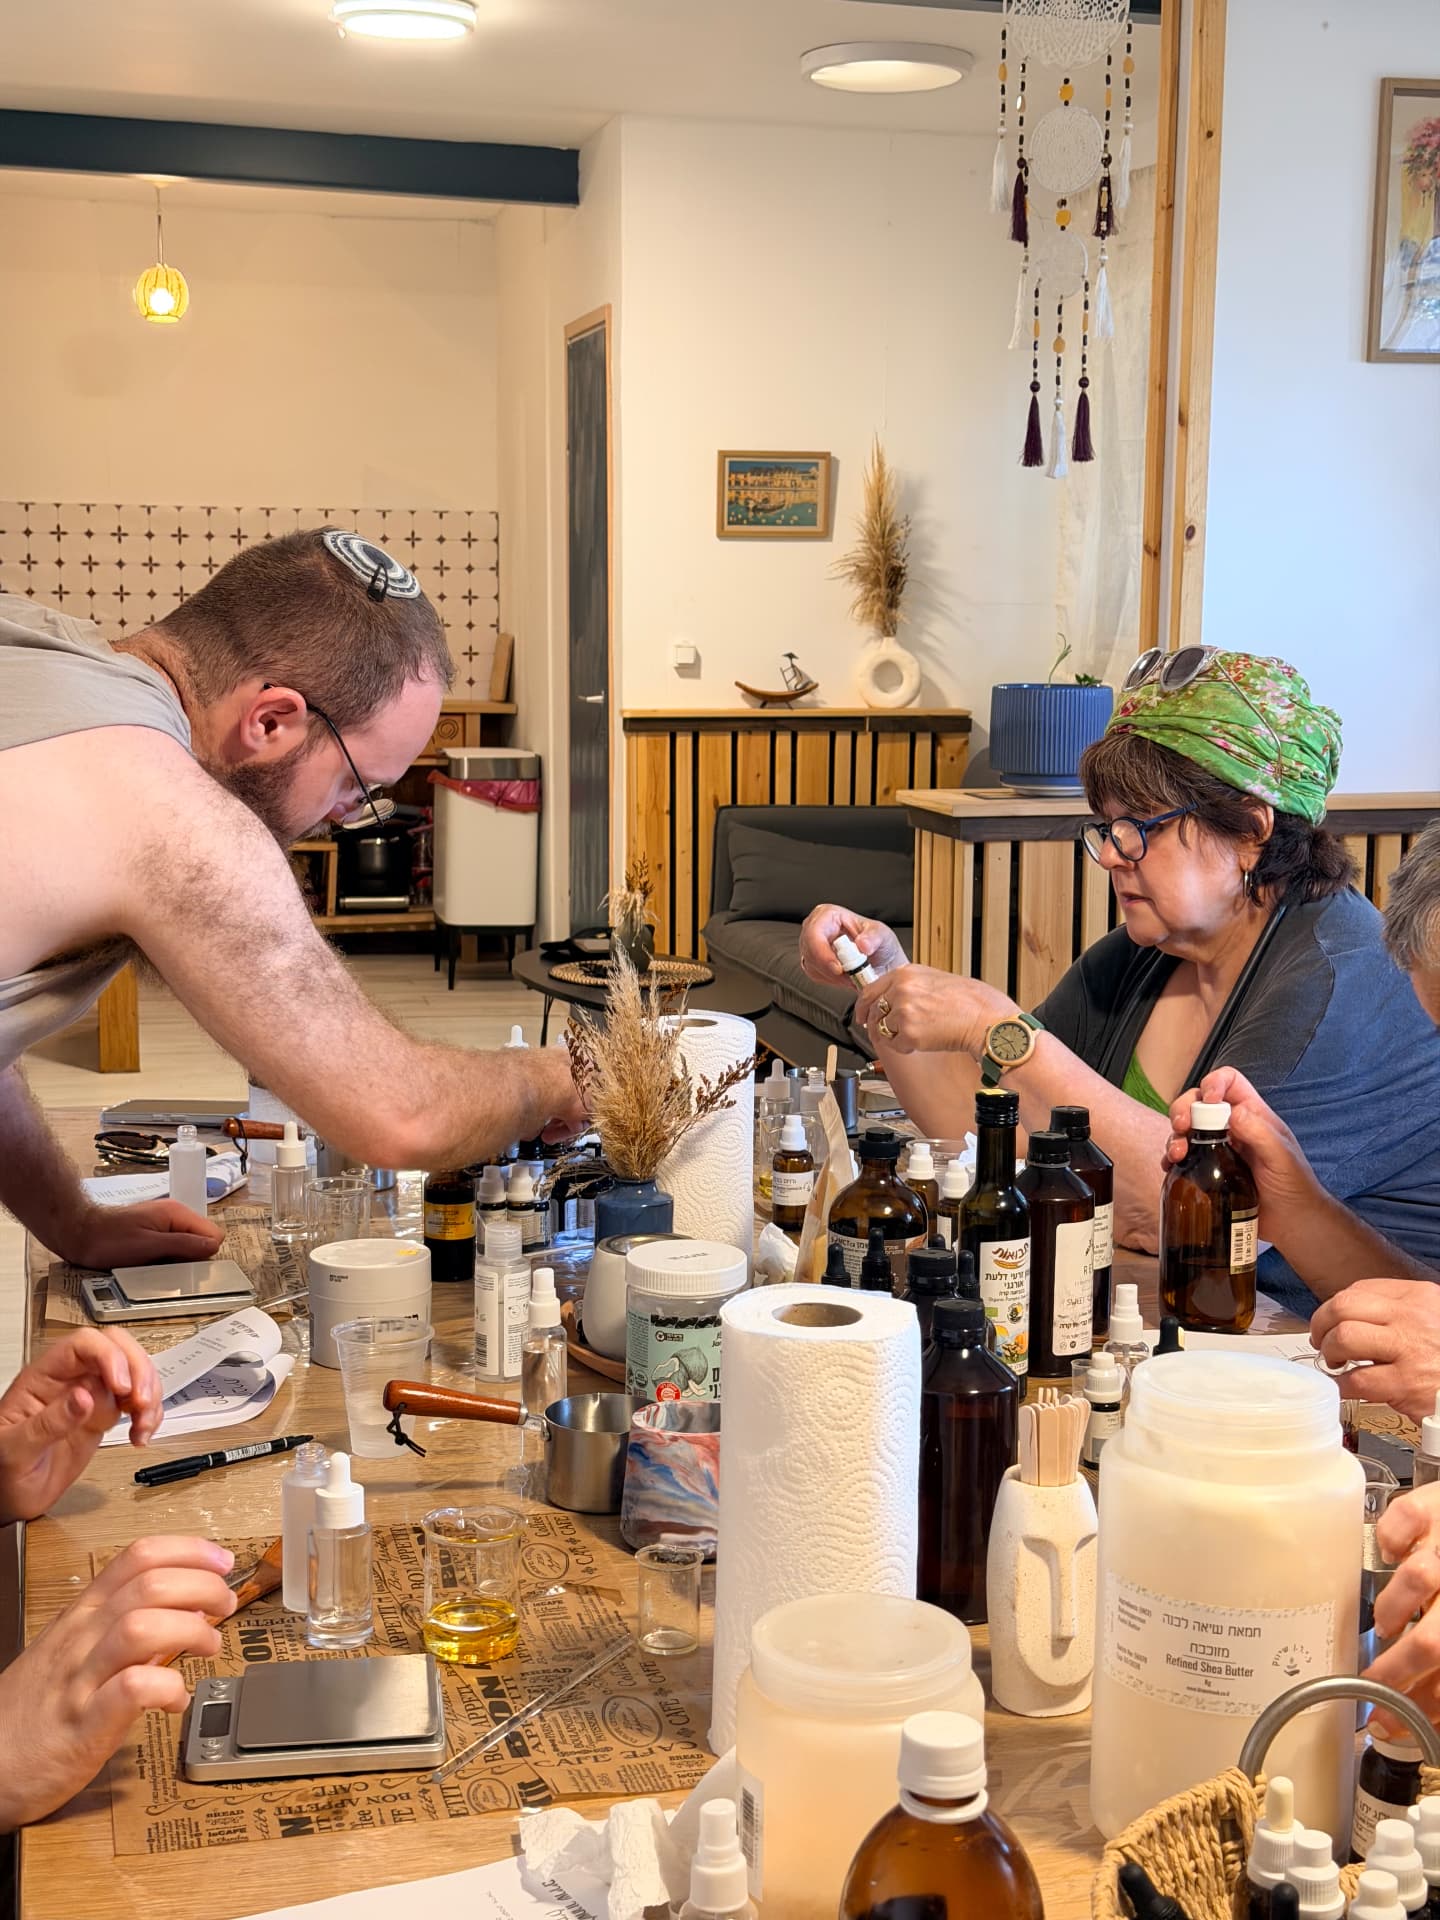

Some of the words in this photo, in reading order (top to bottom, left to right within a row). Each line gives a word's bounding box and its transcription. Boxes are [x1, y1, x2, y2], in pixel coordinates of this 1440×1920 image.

[985, 1271, 1008, 1281] דלעת
[1004, 1280, 1024, 1289] אורגני
[1162, 1613, 1189, 1630] לבנה
[1192, 1620, 1223, 1635] שיאה
[238, 1629, 272, 1662] ON
[270, 1629, 289, 1662] PETIT
[1166, 1653, 1198, 1671] Refined
[1200, 1661, 1223, 1675] Shea
[1225, 1664, 1255, 1678] Butter
[367, 1791, 410, 1805] BON
